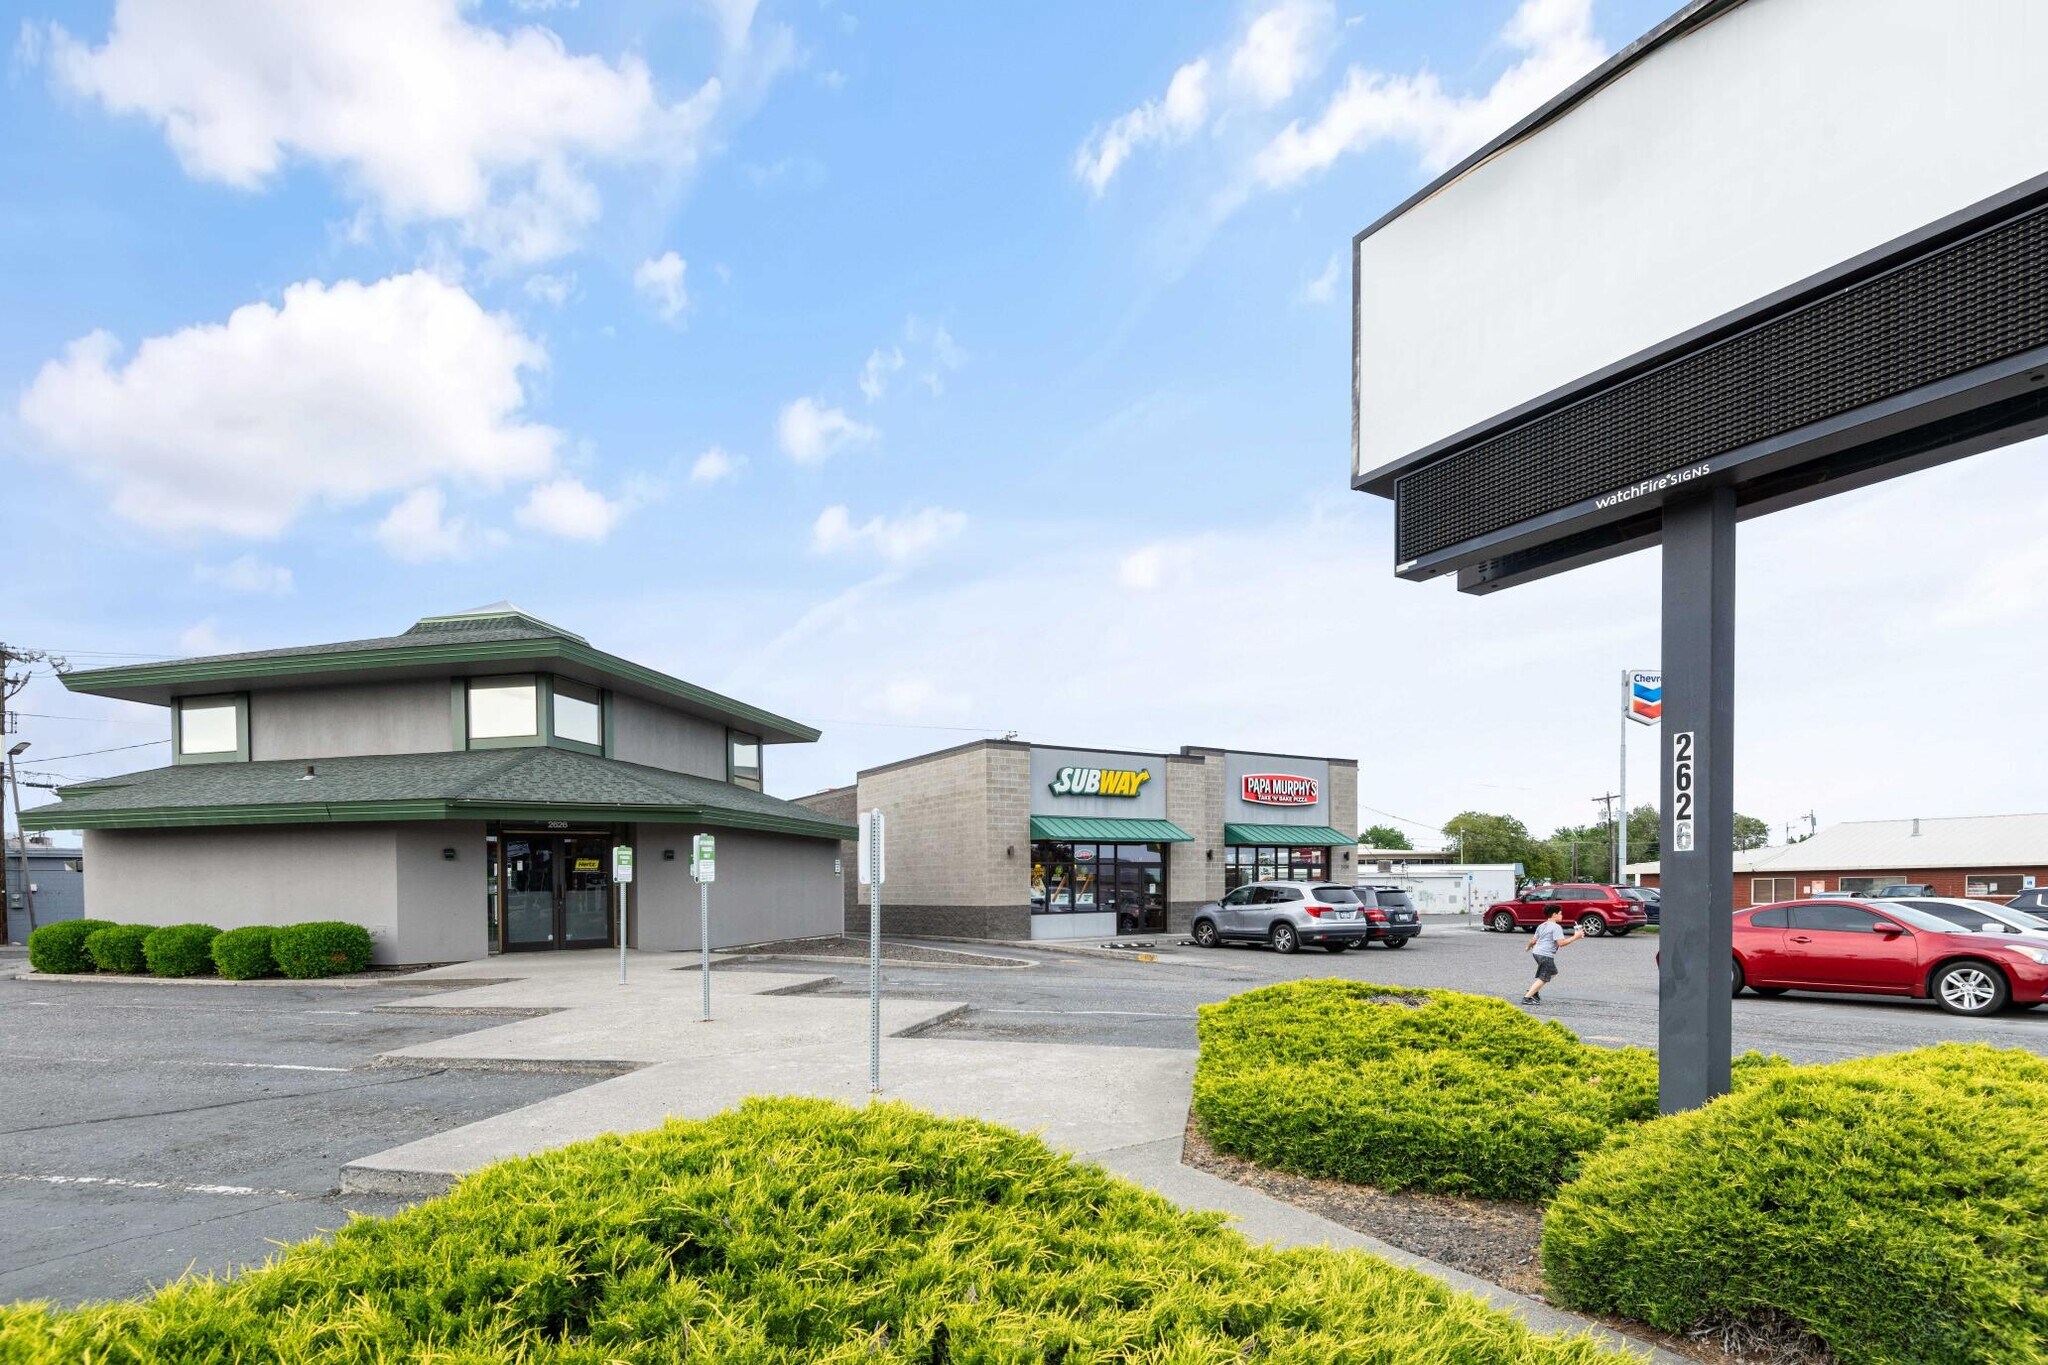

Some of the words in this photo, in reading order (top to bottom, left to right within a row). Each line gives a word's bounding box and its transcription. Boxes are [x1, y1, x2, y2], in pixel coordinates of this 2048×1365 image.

[1671, 464, 1710, 485] SIGNS
[1634, 673, 1662, 683] Chevr
[1053, 767, 1150, 796] SUBWAY
[1247, 777, 1272, 795] PAPA
[1272, 779, 1317, 797] MURPHY'S
[1676, 733, 1692, 850] 2626
